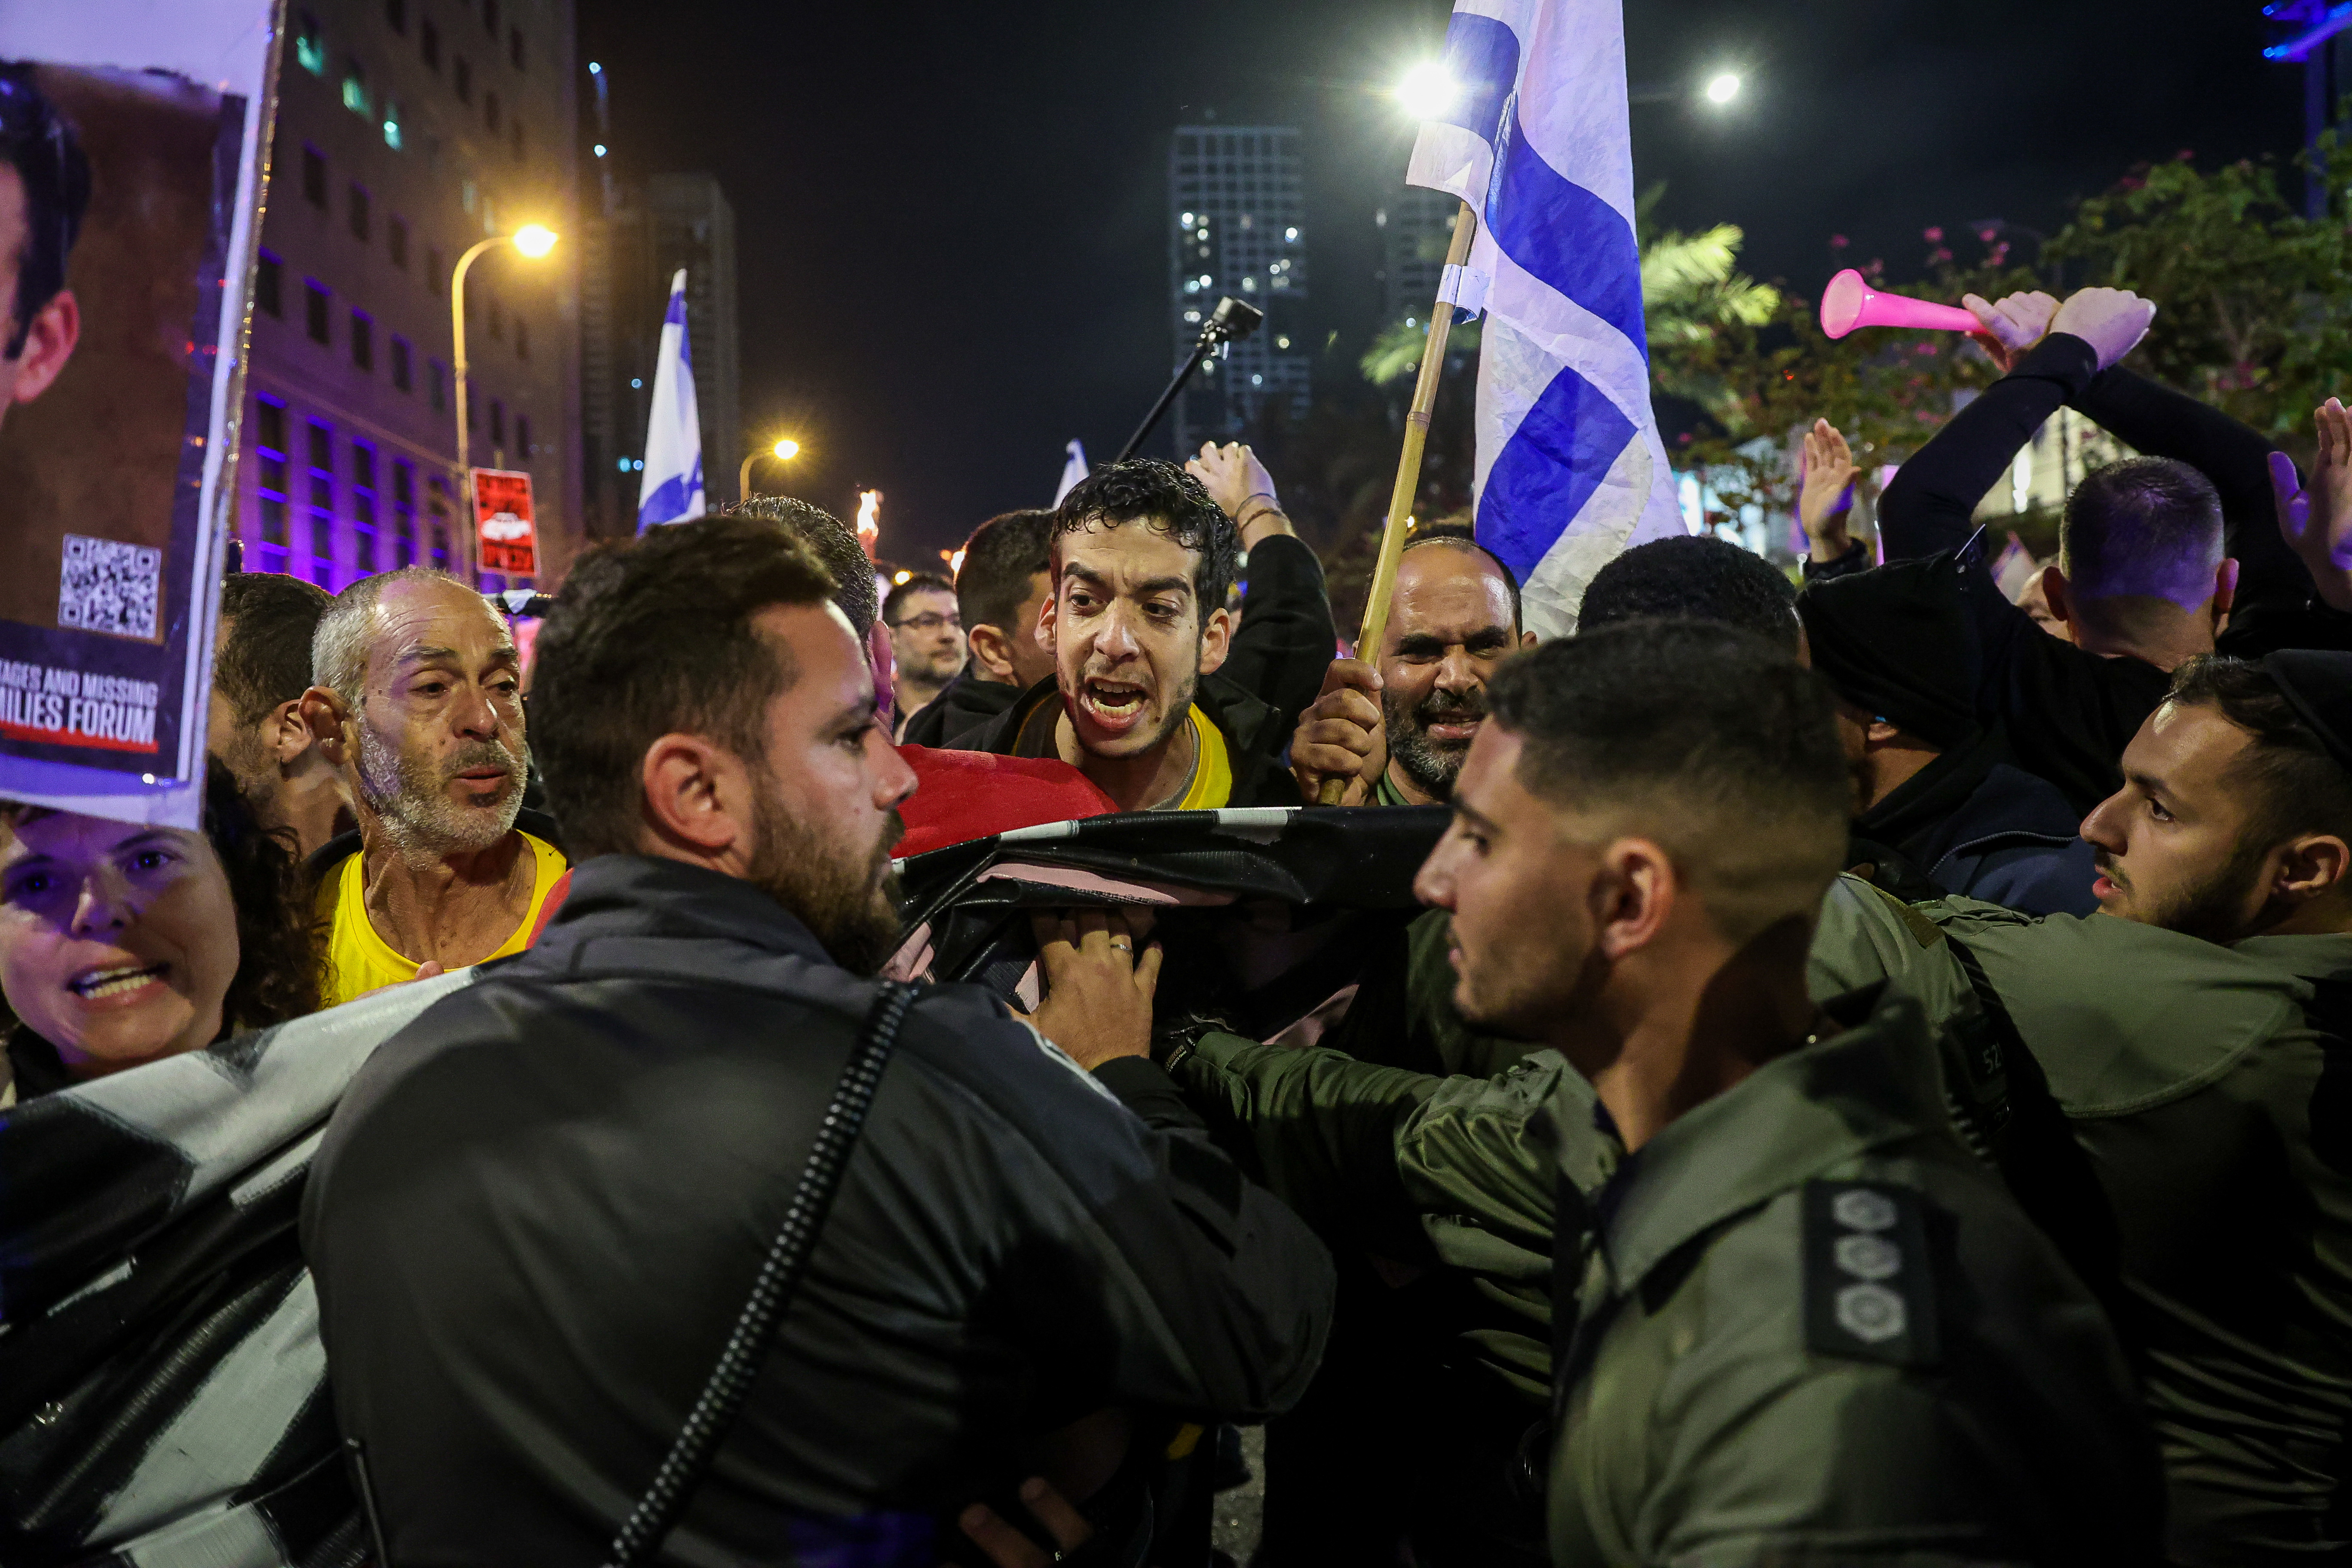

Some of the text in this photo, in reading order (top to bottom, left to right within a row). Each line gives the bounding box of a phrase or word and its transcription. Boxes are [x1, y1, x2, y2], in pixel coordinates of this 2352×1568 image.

[43, 668, 80, 696] AND
[82, 673, 158, 707] MISSING
[67, 697, 156, 744] FORUM
